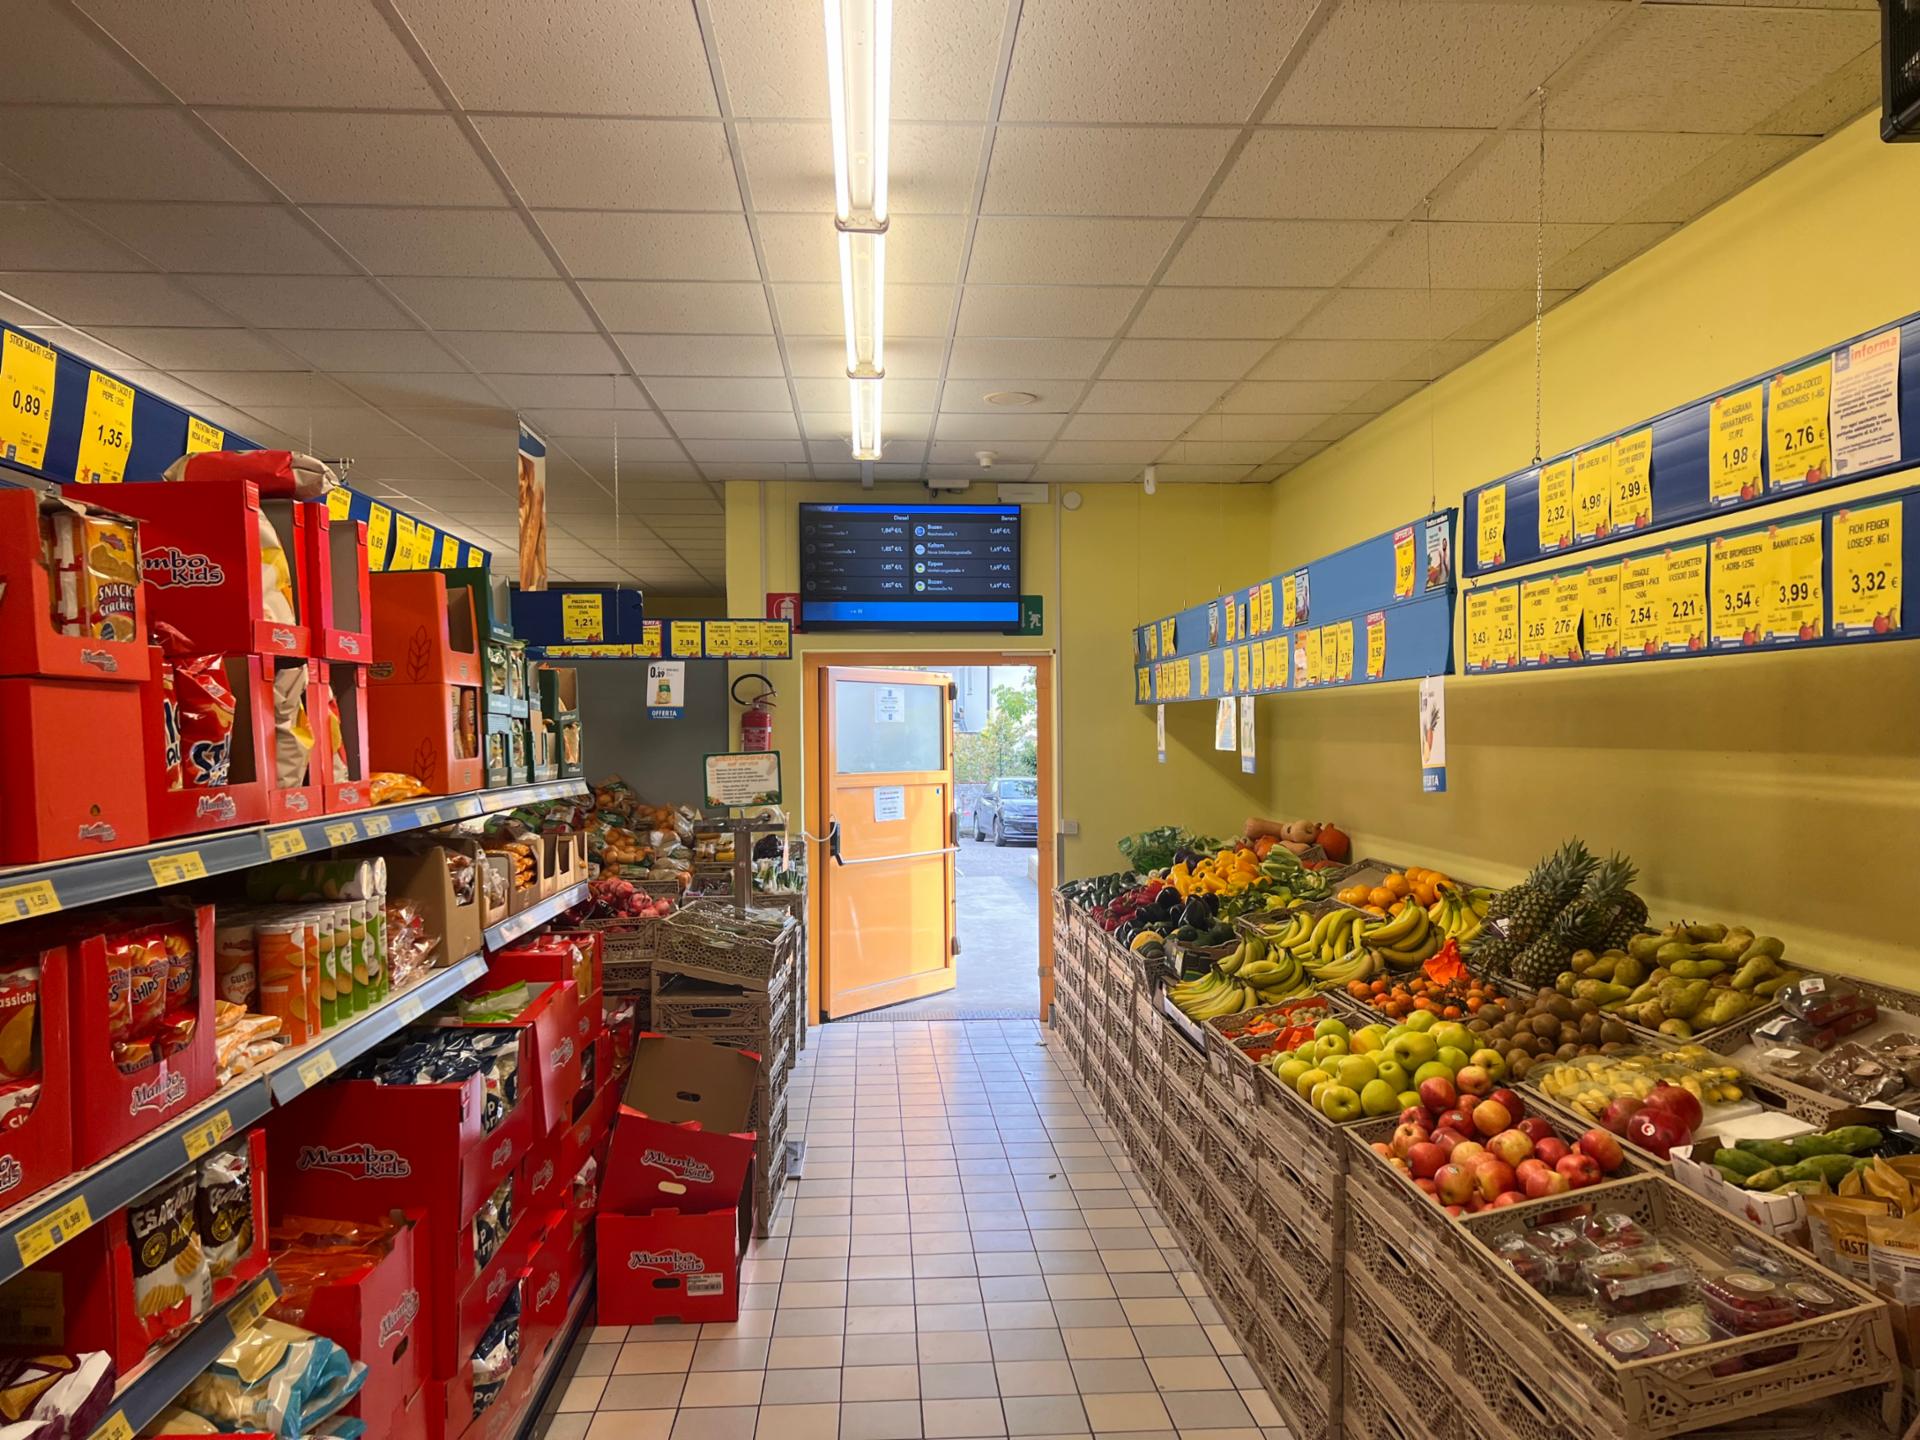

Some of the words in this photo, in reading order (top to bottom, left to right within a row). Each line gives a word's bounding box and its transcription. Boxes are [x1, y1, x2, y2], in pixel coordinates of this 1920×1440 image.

[1851, 336, 1897, 361] informa
[12, 389, 41, 416] 0,89
[102, 390, 114, 404] PEPE
[97, 424, 123, 448] 1,35
[1785, 425, 1815, 451] 2,76
[1723, 446, 1748, 470] 1,98
[1621, 480, 1641, 501] 2,99
[1582, 494, 1602, 512] 4,98
[1547, 505, 1565, 523] 2,32
[1848, 523, 1865, 536] FICHI
[1865, 518, 1890, 533] FEIGEN
[371, 535, 384, 549] 0,89
[144, 549, 208, 571] mbo
[171, 566, 221, 584] Kids
[1851, 569, 1886, 596] 3,32
[98, 583, 134, 601] SNACK
[1779, 581, 1809, 606] 3,99
[1672, 599, 1695, 620] 2,21
[1725, 590, 1751, 613] 3,54
[574, 618, 594, 629] 1,21
[1593, 612, 1612, 630] 1,76
[1630, 606, 1651, 625] 2,54
[1498, 627, 1512, 642] 2,43
[1529, 622, 1545, 639] 2,65
[1554, 619, 1572, 636] 2,76
[1473, 630, 1486, 645] 3,43
[167, 966, 192, 993] CHIPS
[132, 975, 160, 1004] CHIPS
[300, 1146, 395, 1168] Mambo
[644, 1149, 706, 1171] Mambo
[363, 1161, 410, 1178] Kids
[683, 1165, 713, 1182] Kids
[631, 1250, 693, 1267] Mambo
[672, 1260, 704, 1272] Kids
